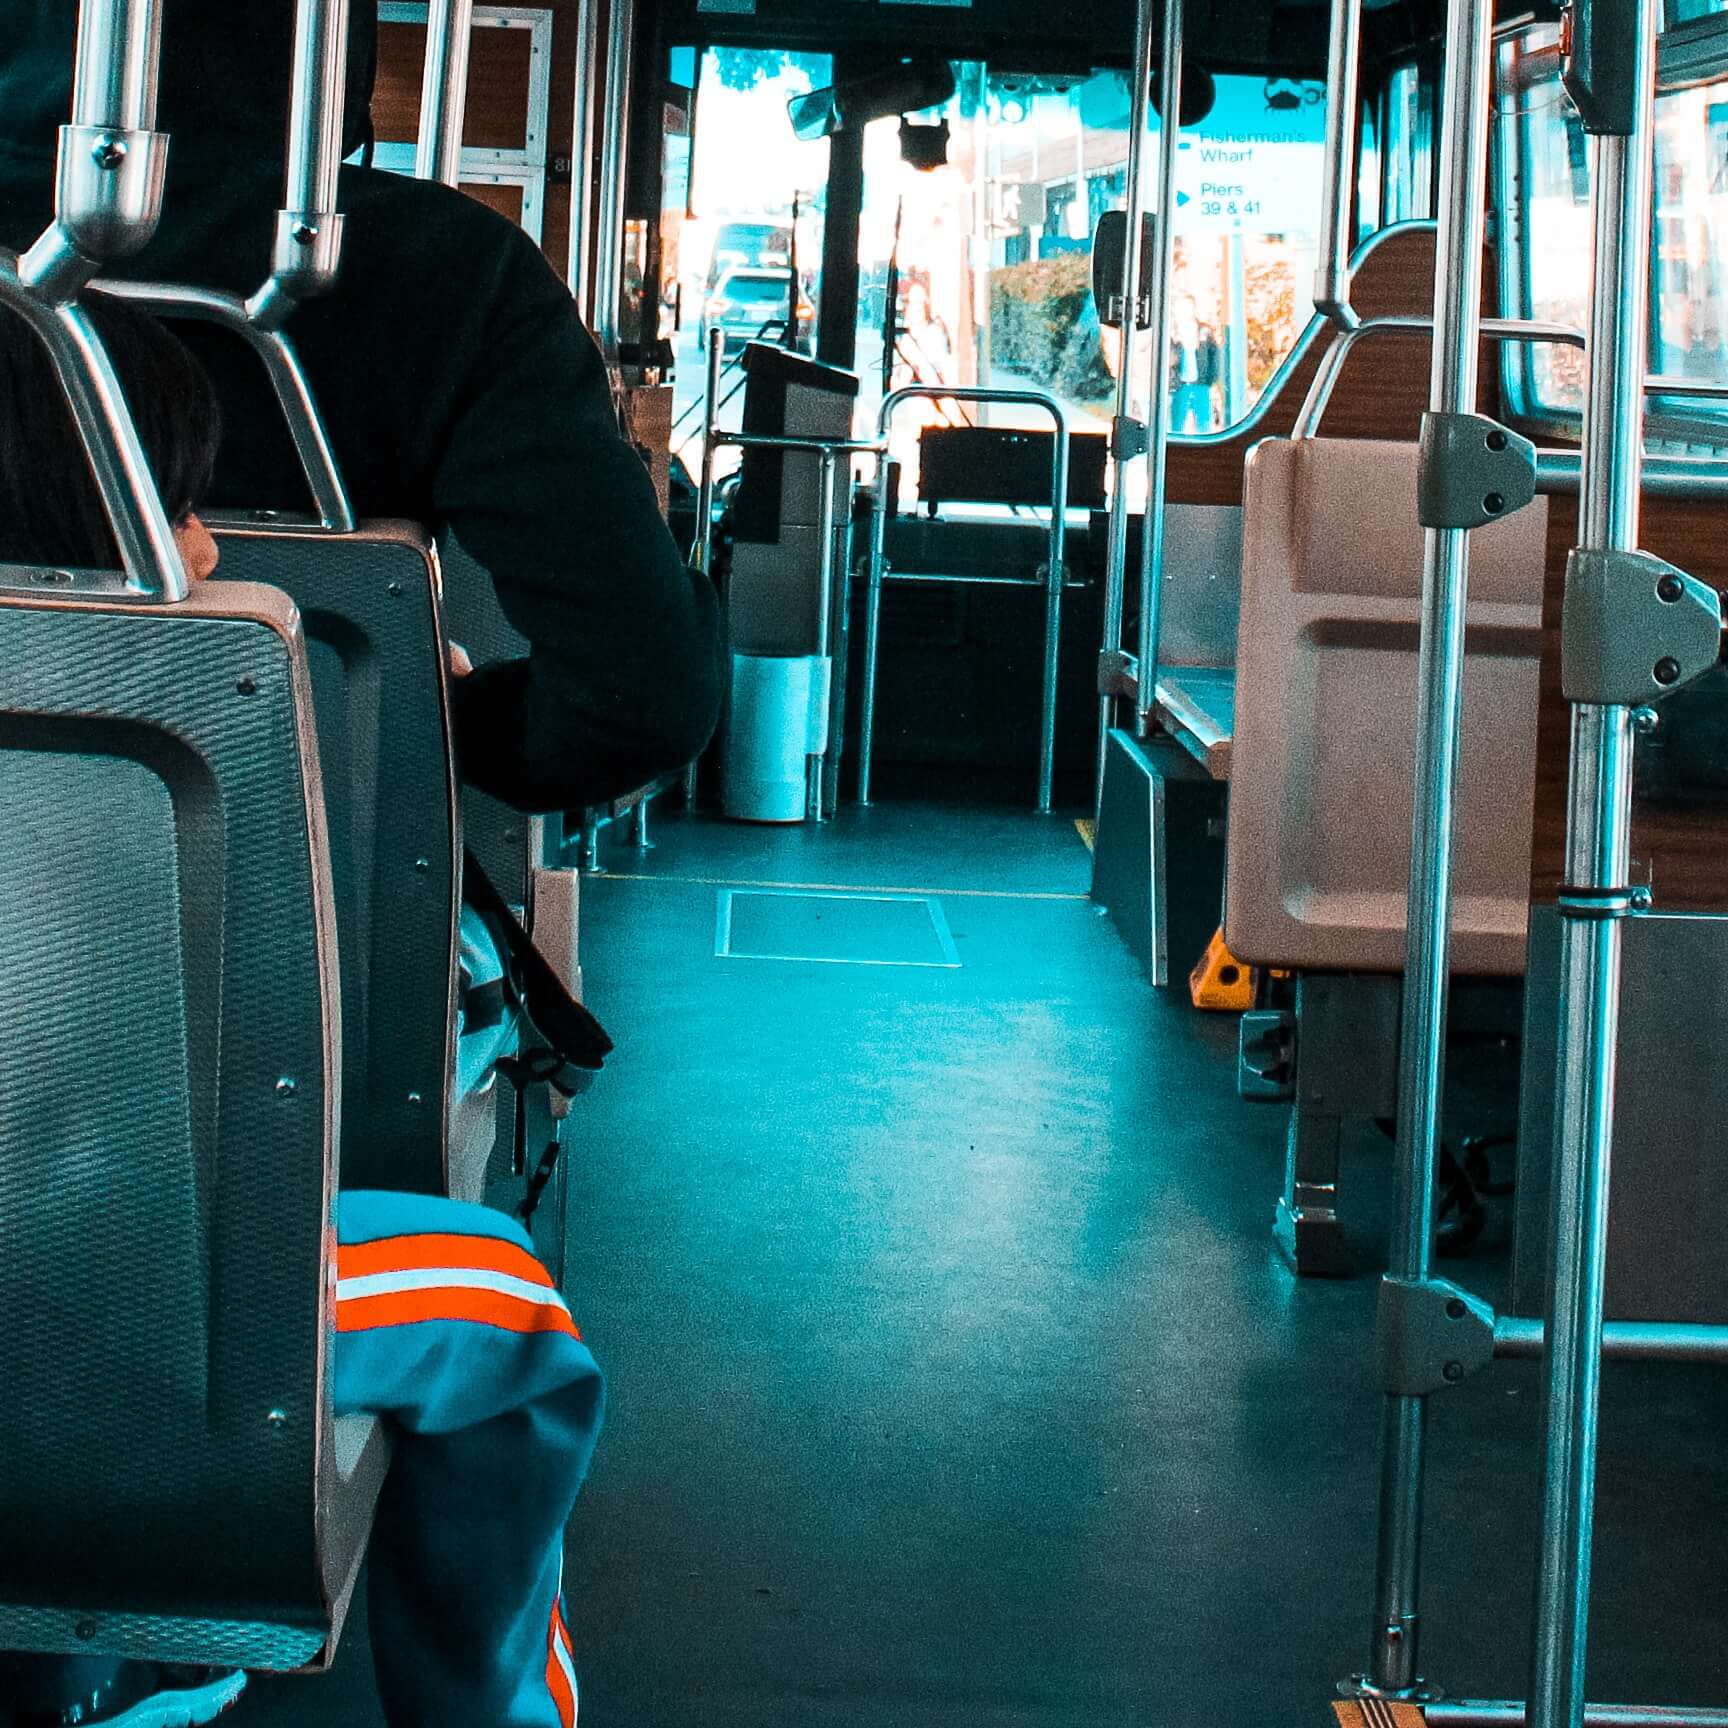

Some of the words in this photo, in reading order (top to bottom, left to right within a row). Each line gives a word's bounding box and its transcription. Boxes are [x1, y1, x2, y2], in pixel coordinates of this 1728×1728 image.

[1199, 129, 1306, 144] Fisherman's
[1200, 148, 1253, 163] Wharf
[1201, 182, 1243, 197] Piers
[1201, 201, 1222, 216] 39
[1226, 201, 1238, 215] &
[1244, 200, 1261, 215] 41
